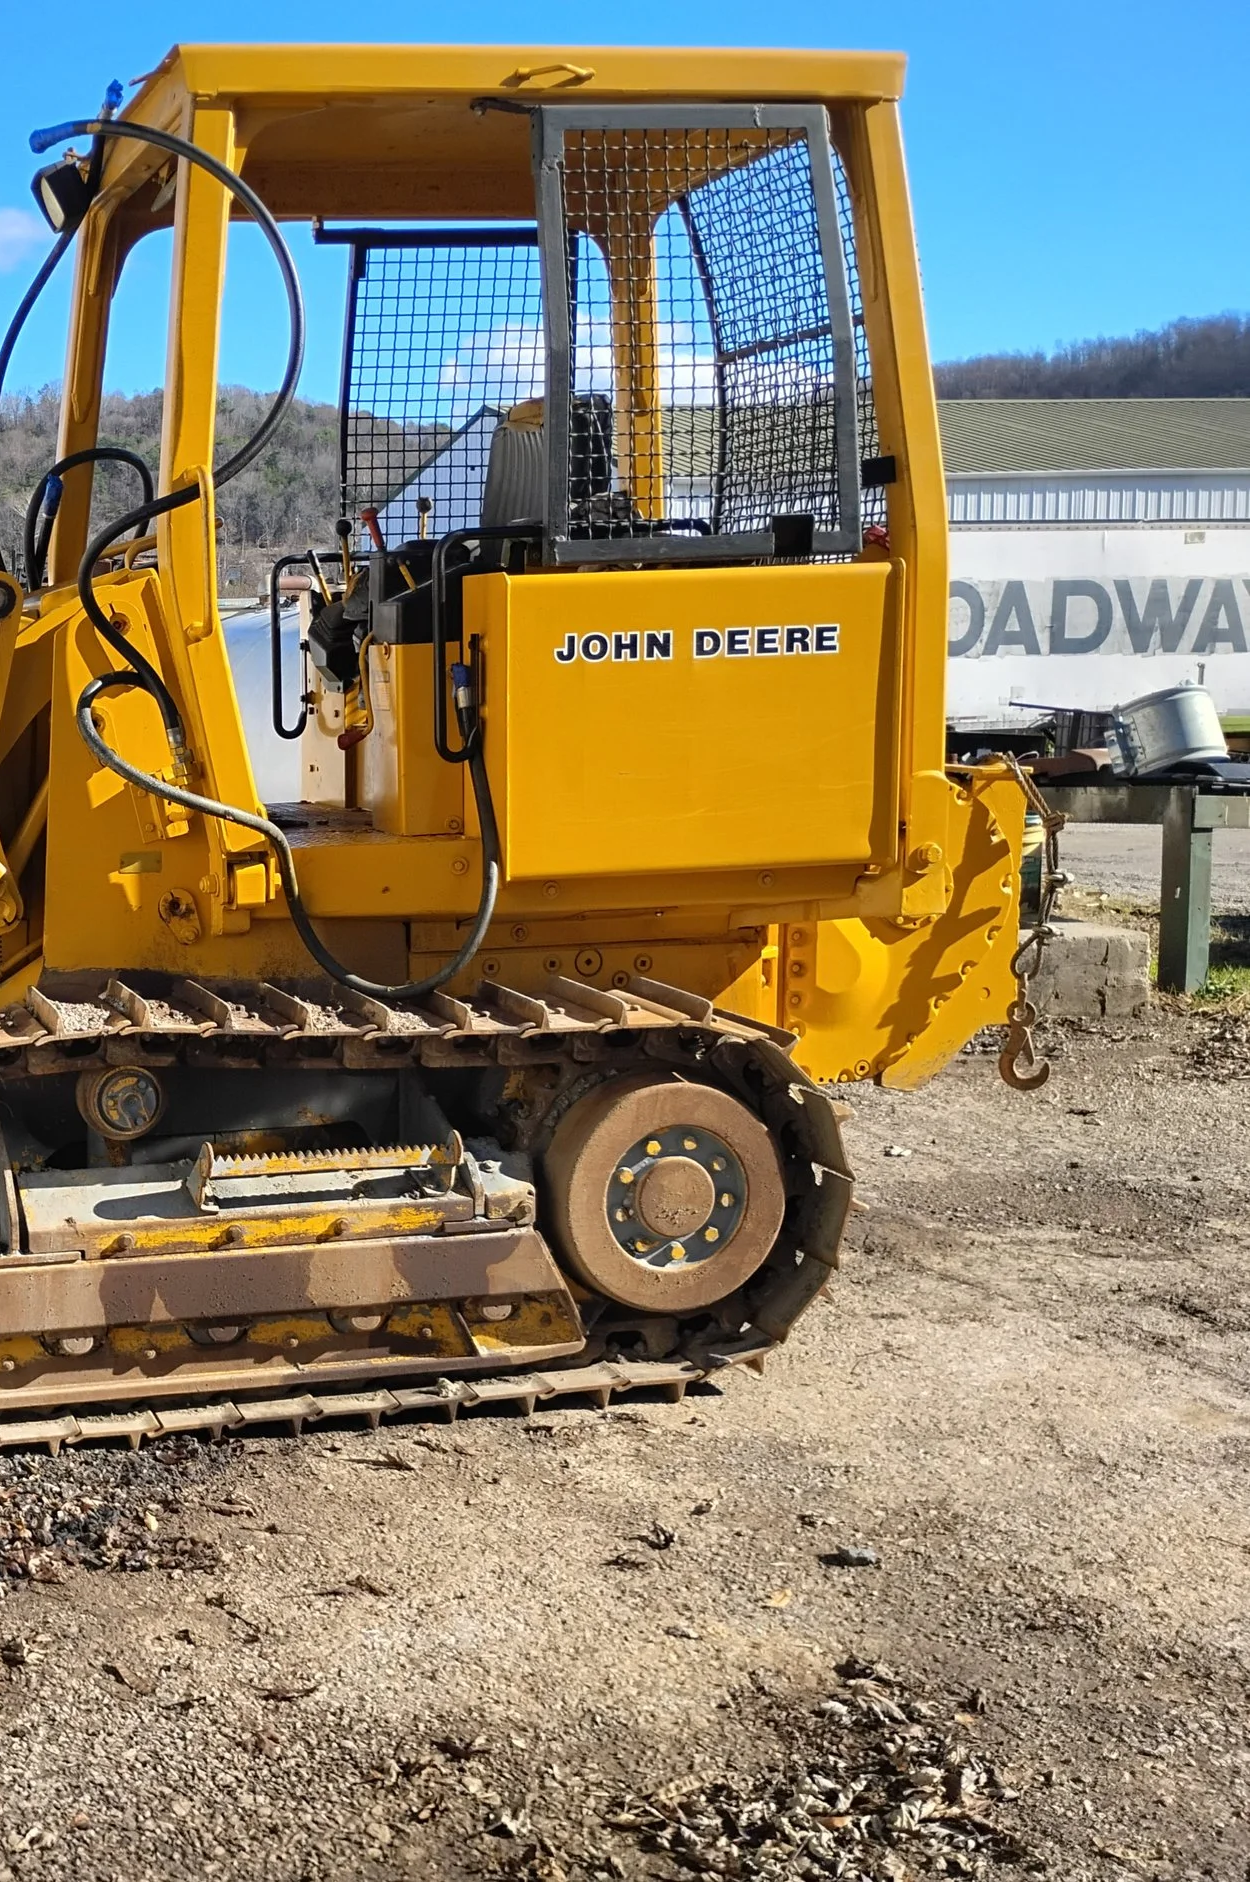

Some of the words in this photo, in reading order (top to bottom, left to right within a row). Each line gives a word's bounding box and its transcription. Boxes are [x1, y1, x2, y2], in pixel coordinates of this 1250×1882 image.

[554, 630, 673, 664] JOHN
[692, 623, 841, 659] DEERE
[947, 578, 1250, 656] OADWA
